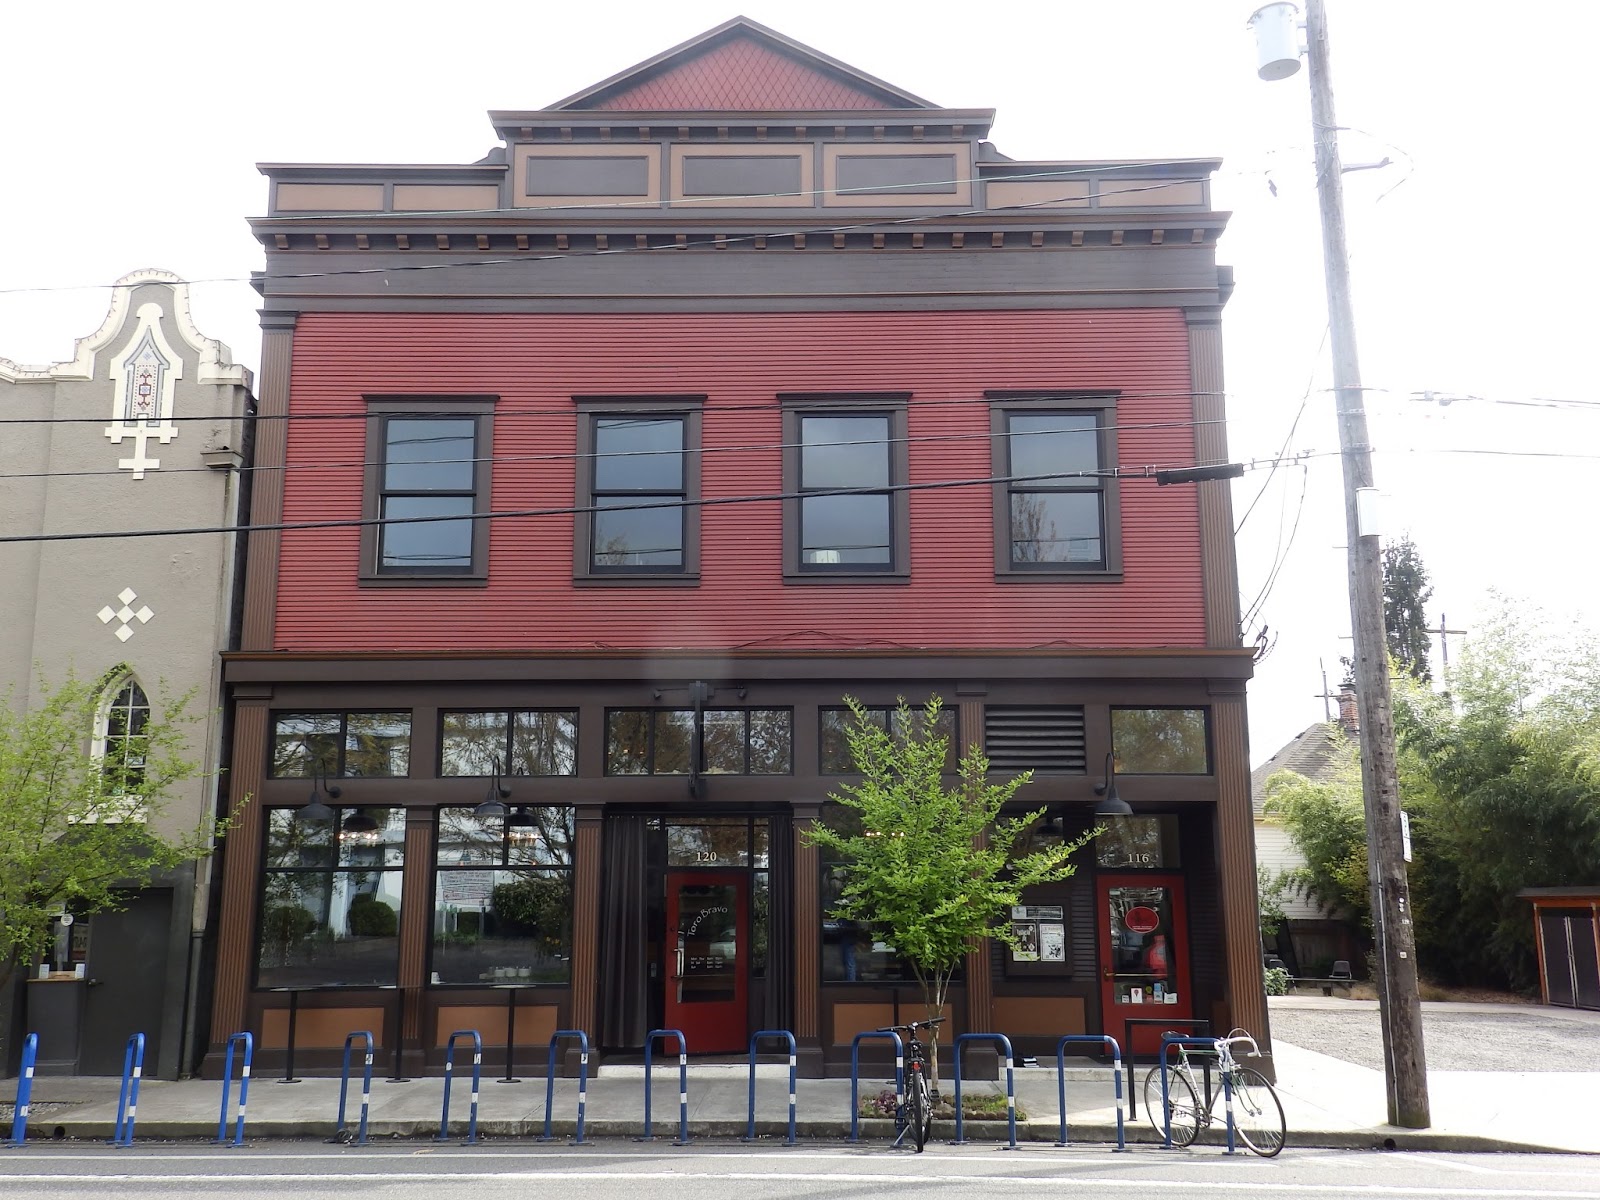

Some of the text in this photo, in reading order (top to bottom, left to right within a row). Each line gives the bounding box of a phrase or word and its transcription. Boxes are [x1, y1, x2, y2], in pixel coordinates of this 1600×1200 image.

[696, 851, 717, 862] 120
[1128, 853, 1149, 863] 116
[686, 906, 728, 937] Toro Bravo
